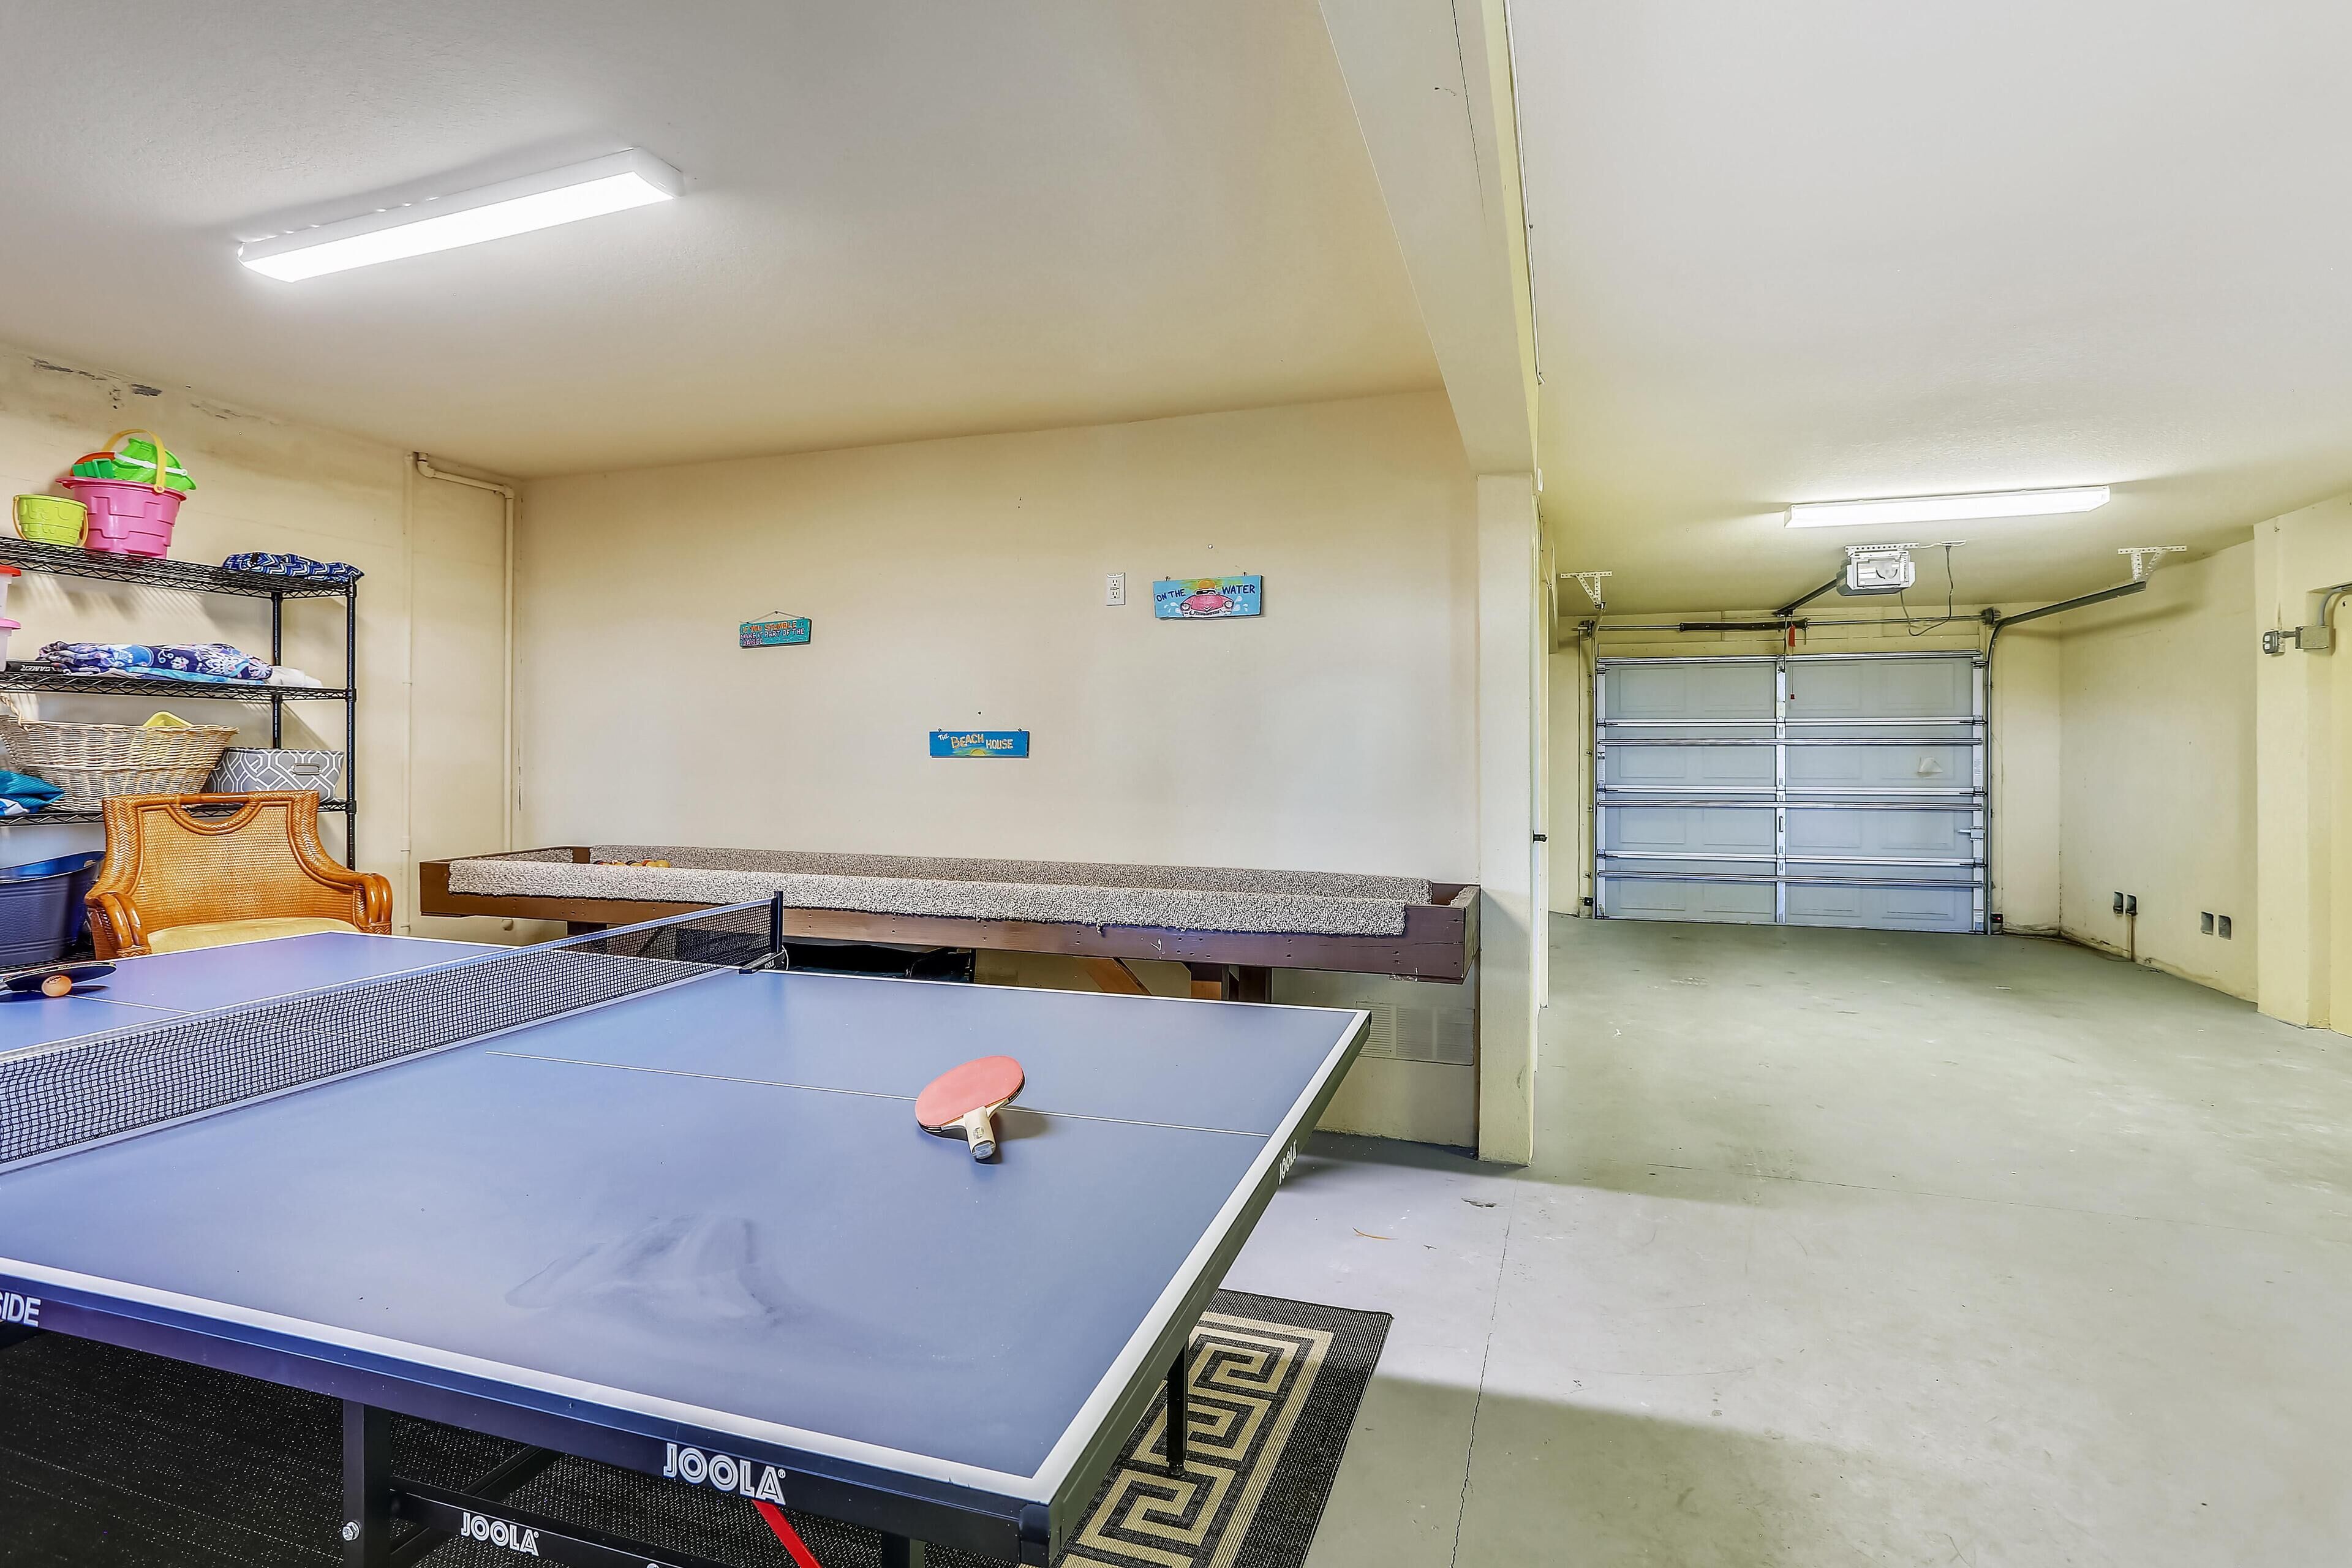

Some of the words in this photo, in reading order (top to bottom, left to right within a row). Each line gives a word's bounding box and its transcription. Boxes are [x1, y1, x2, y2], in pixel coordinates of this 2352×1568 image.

[1156, 593, 1167, 602] ON
[1168, 589, 1186, 598] THE
[1222, 584, 1256, 595] WATER
[764, 620, 797, 631] STUMBLE
[950, 733, 984, 749] BEACH
[986, 739, 1014, 750] HOUSE
[0, 1290, 41, 1328] IDE
